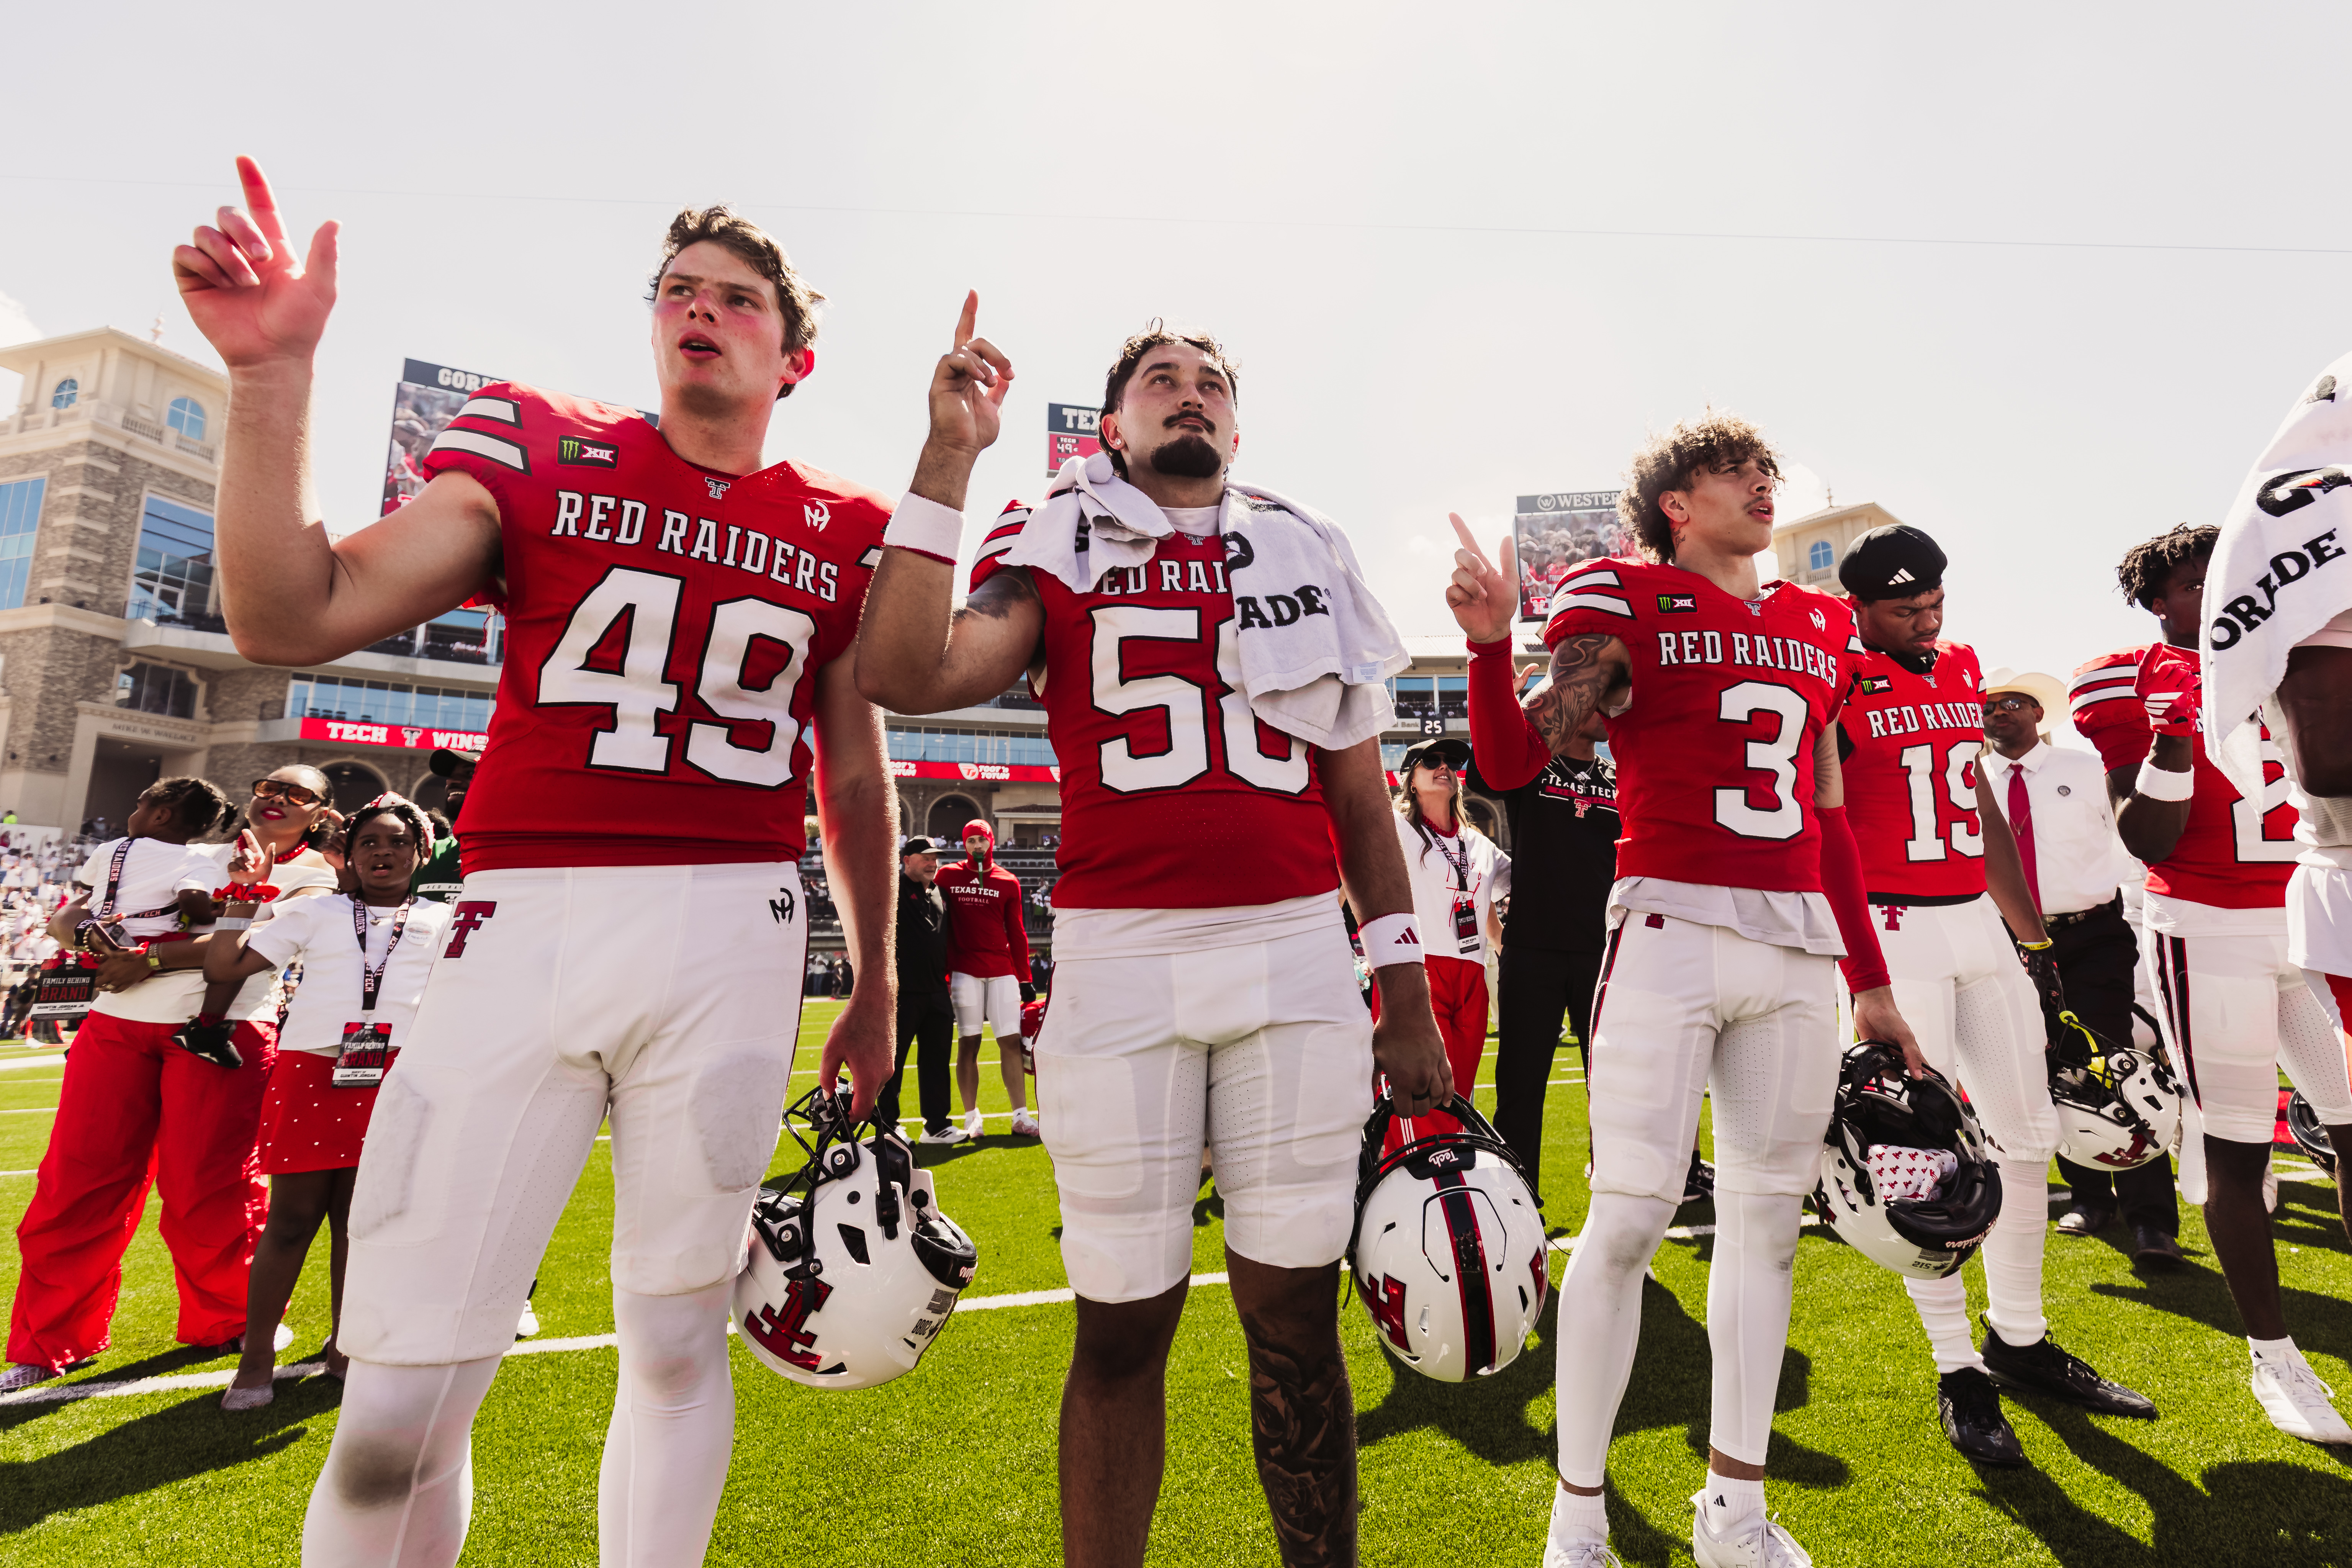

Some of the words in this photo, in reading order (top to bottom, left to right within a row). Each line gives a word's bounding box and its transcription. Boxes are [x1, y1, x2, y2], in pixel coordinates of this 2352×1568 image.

[1057, 444, 1072, 453] 49
[552, 491, 647, 545] RED
[658, 509, 839, 602] RAIDERS
[1090, 564, 1147, 595] ED
[1658, 631, 1722, 665] RED
[1732, 633, 1837, 689] RAIDERS
[537, 567, 816, 787] 49
[1425, 720, 1442, 734] 25
[1866, 706, 1920, 738] RED
[327, 722, 388, 743] TECH
[432, 732, 489, 749] WINS
[1716, 682, 1808, 839] 3
[891, 768, 917, 777] OTUM
[1900, 741, 1984, 861] 19
[1435, 837, 1447, 849] TECH
[110, 853, 126, 881] RAIDERS
[1444, 850, 1457, 866] TEXAS
[978, 888, 999, 898] TECH
[355, 910, 365, 935] RAIDERS
[365, 974, 375, 992] TECH
[39, 987, 88, 1001] BRAND
[341, 1052, 382, 1066] BRAND
[1429, 1149, 1459, 1168] Tech
[1945, 1232, 1985, 1249] Raiders
